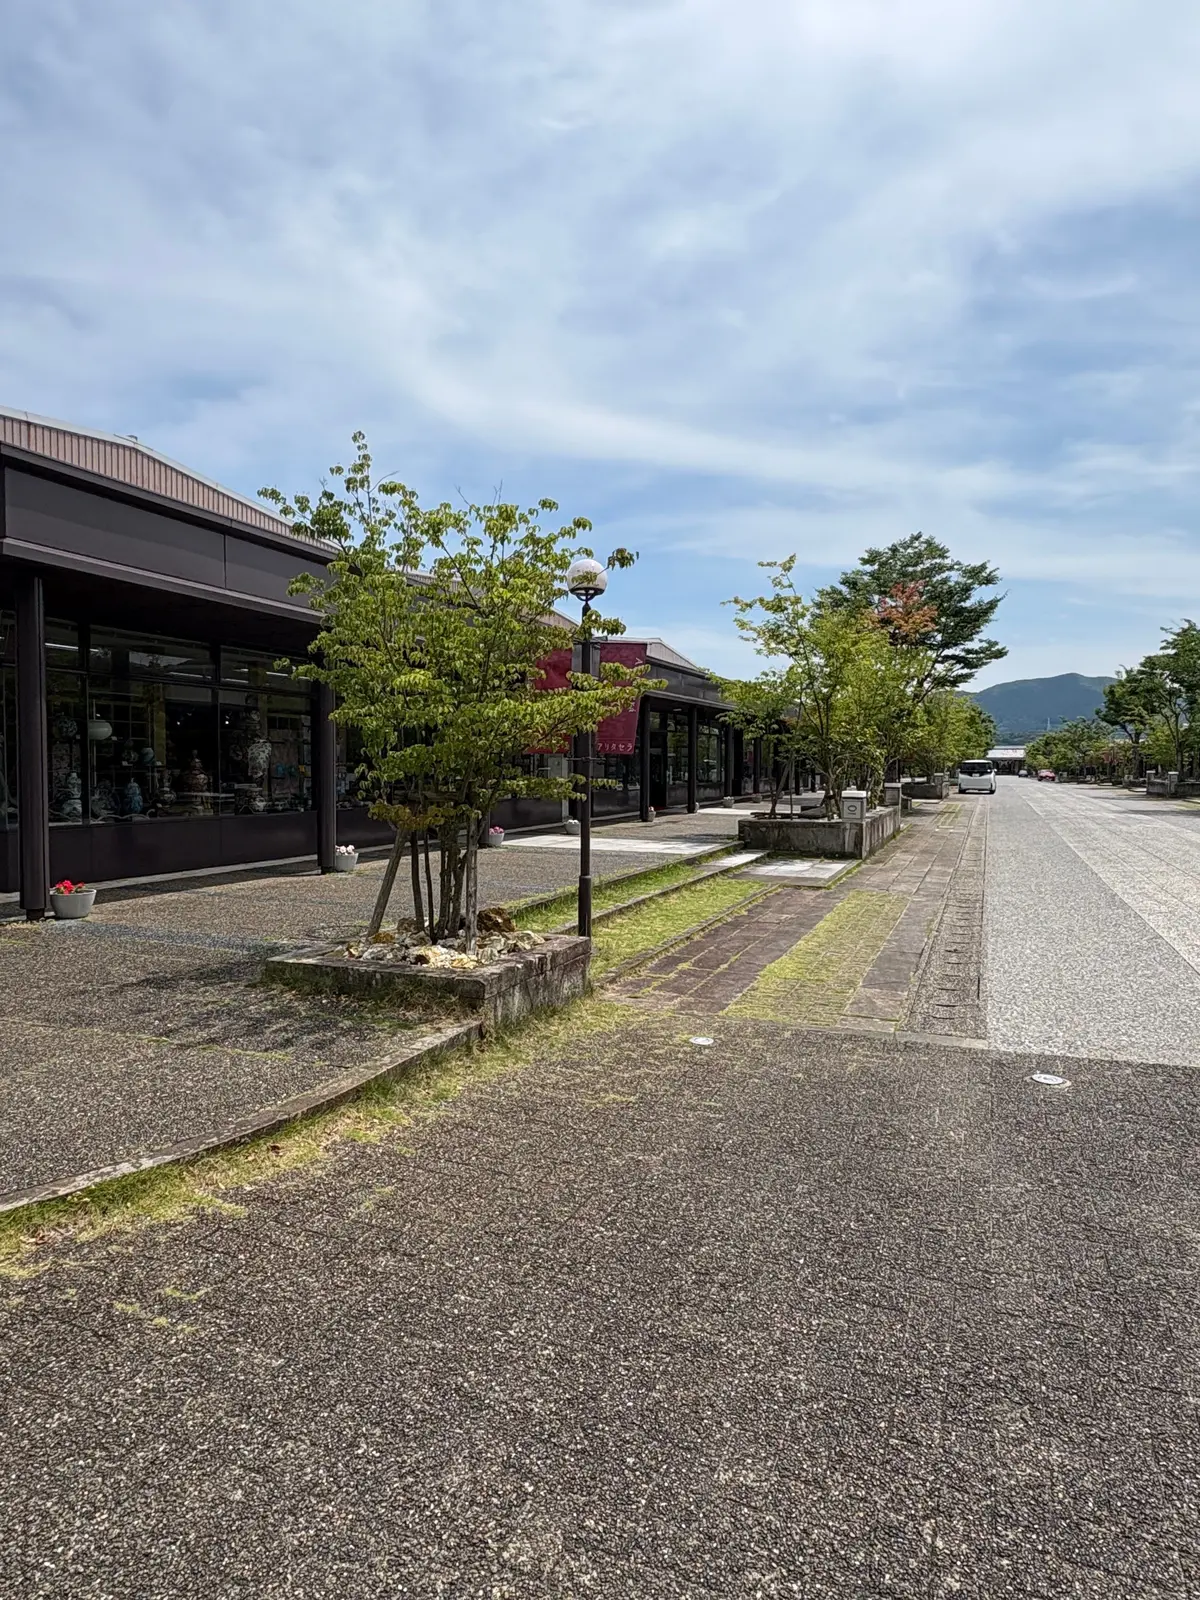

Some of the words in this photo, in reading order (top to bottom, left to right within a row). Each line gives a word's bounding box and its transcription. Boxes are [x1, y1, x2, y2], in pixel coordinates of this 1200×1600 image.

[596, 743, 633, 752] アリタセラ
